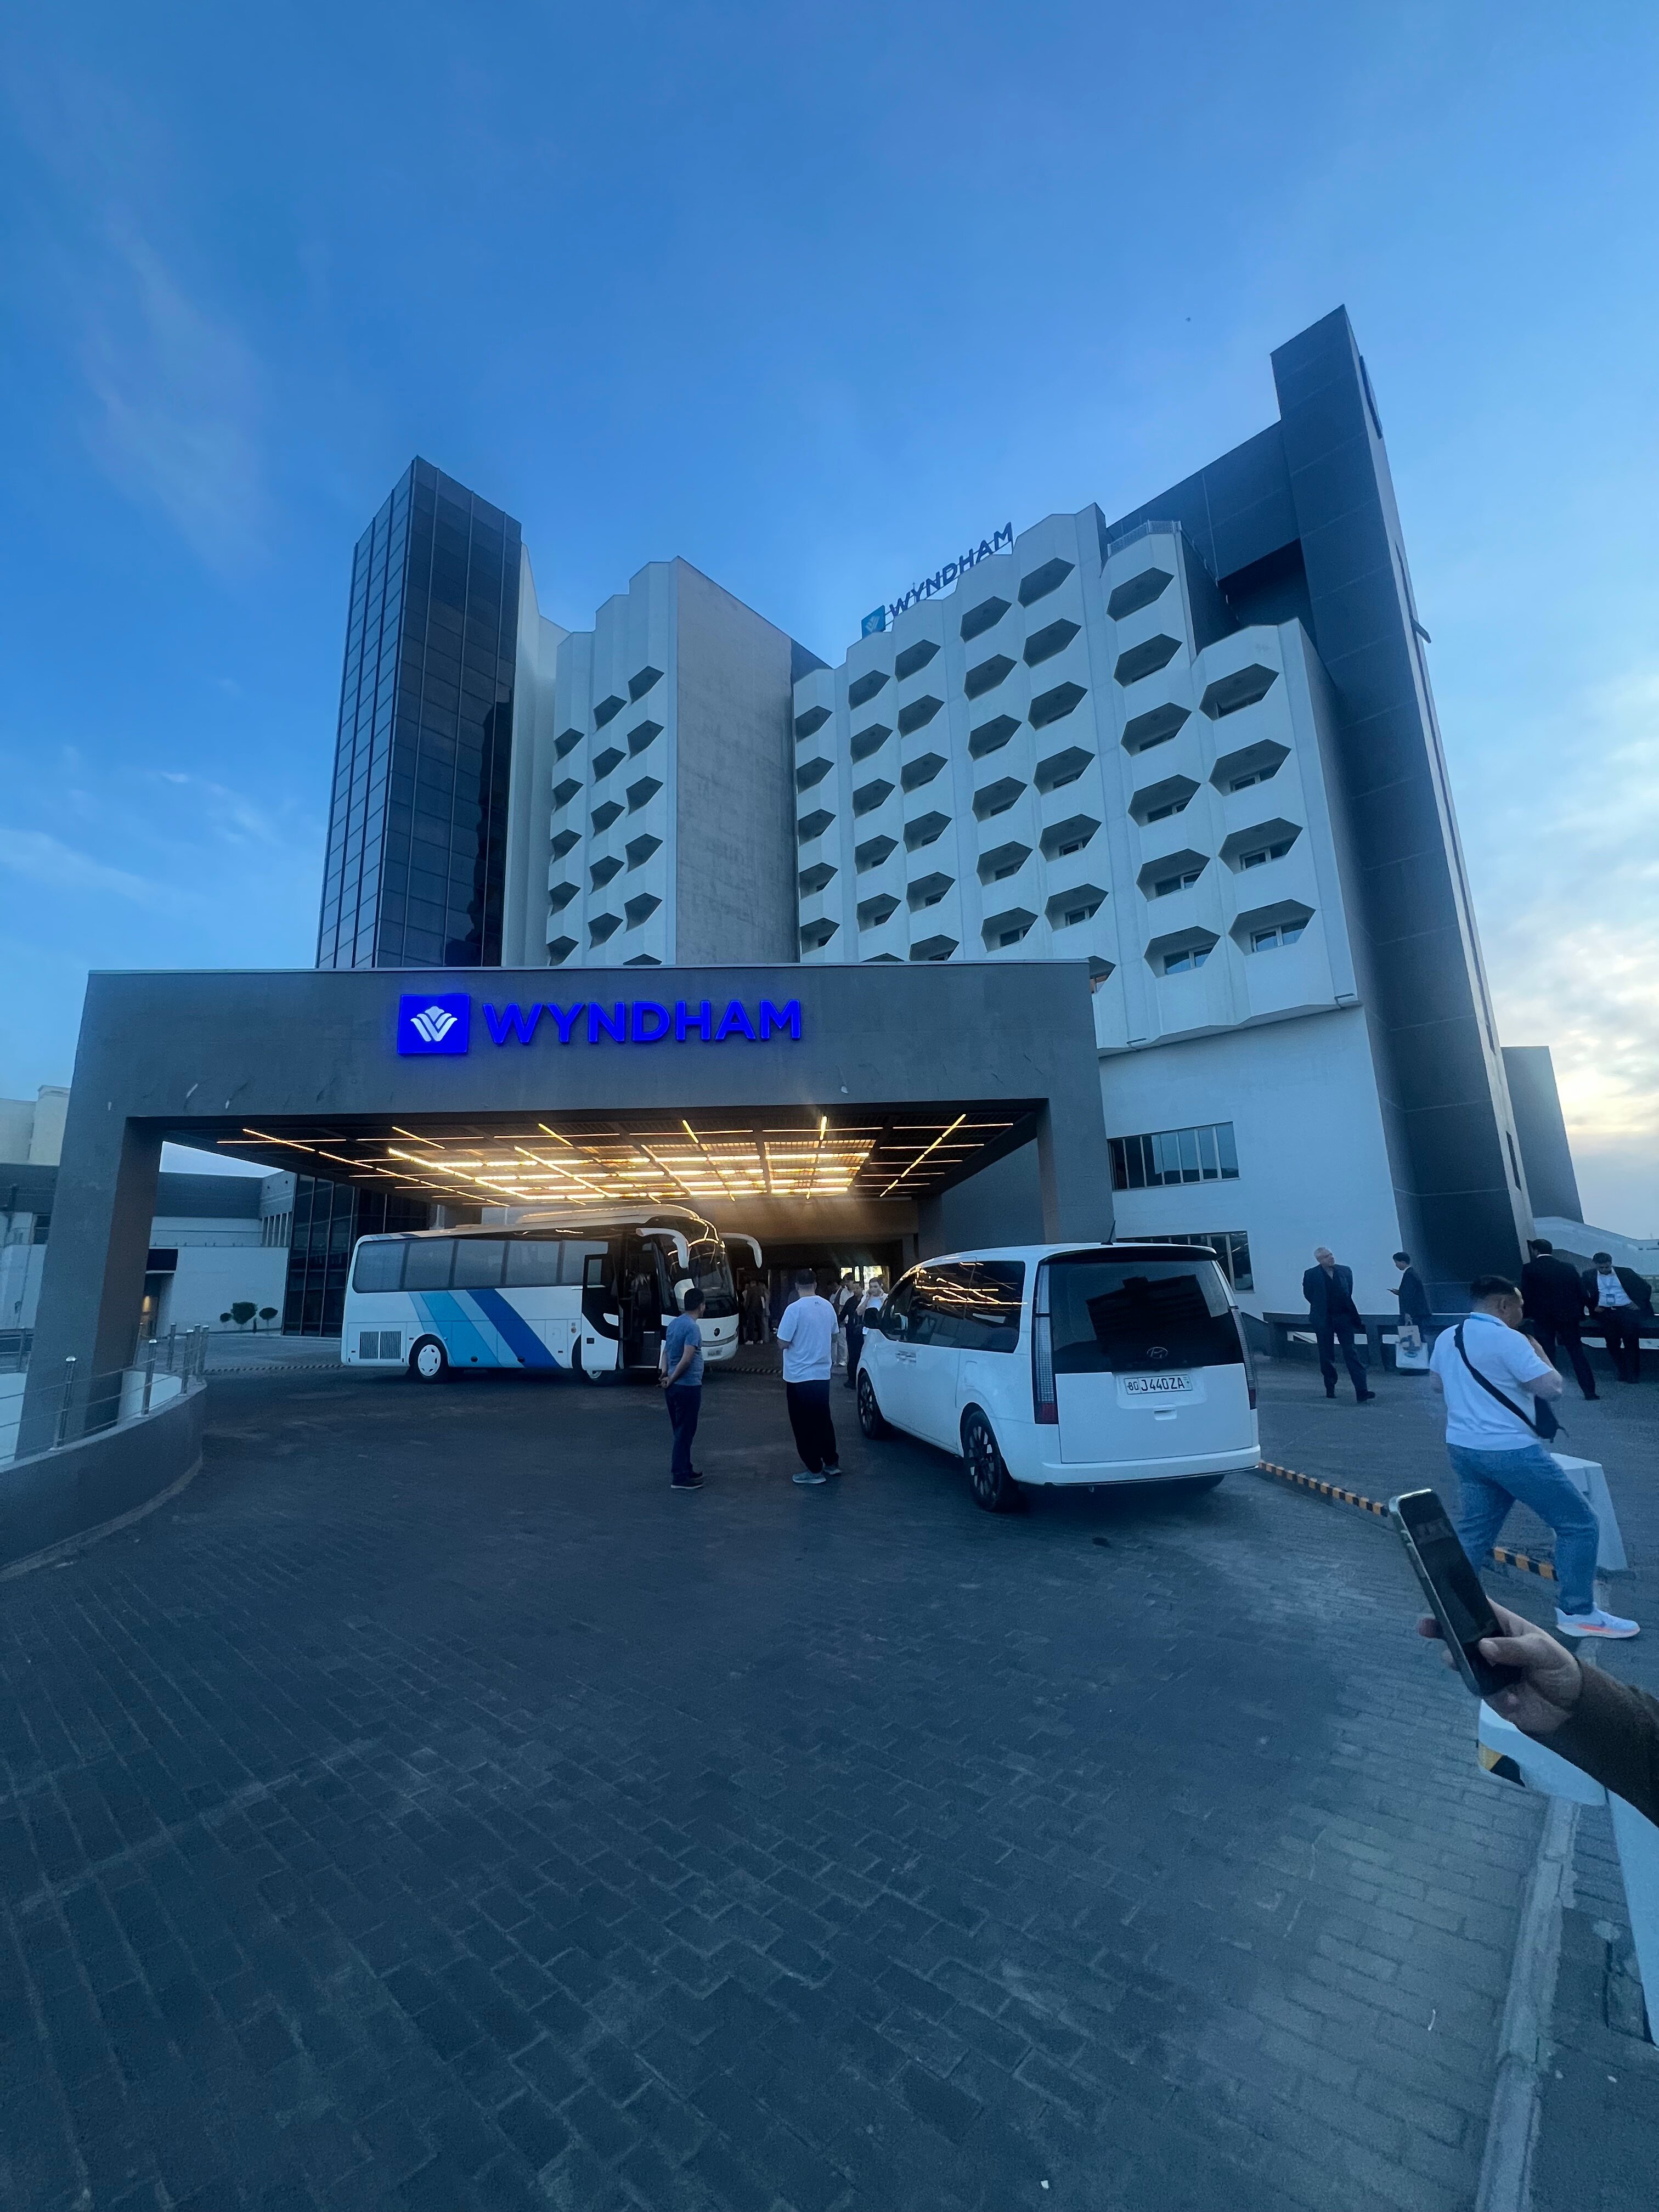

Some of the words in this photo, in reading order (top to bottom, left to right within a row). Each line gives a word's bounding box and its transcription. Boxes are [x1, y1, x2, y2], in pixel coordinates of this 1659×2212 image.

[889, 522, 1013, 617] WYNDHAM
[482, 1000, 801, 1043] WYNDHAM
[1127, 1381, 1139, 1391] 80
